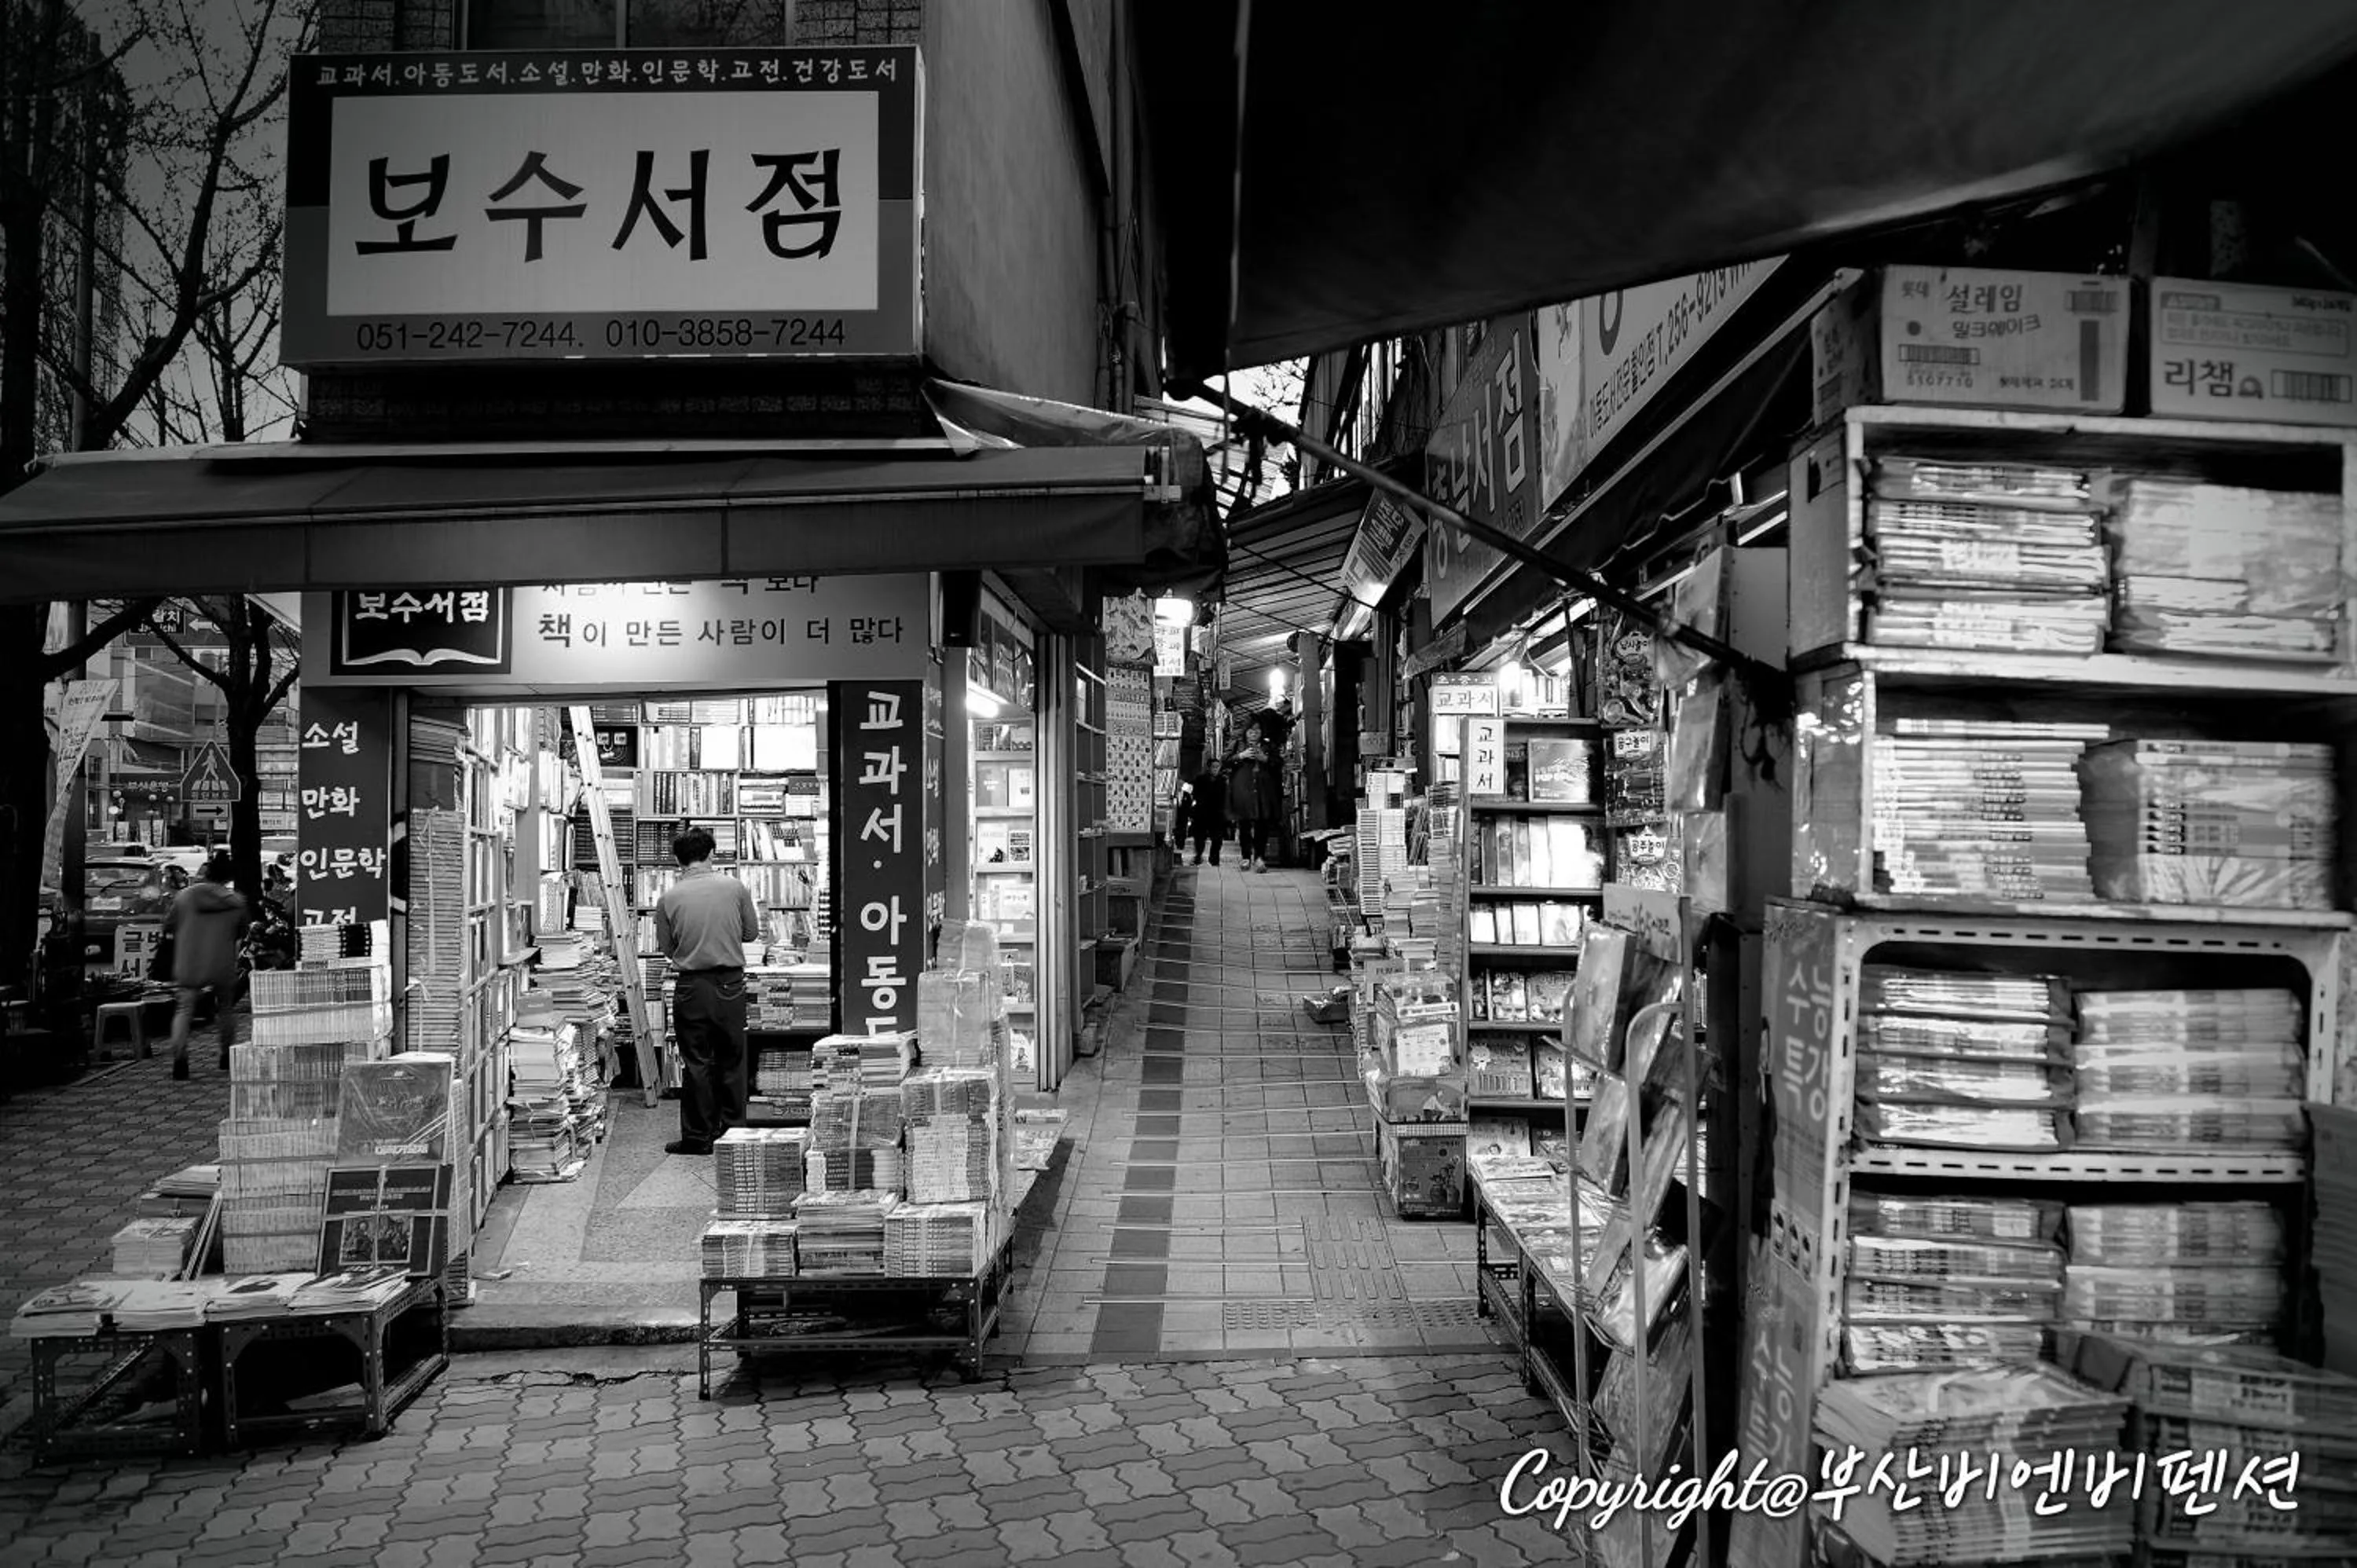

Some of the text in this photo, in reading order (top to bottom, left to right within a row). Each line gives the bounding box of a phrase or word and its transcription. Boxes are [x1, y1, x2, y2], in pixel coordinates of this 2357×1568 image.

[355, 148, 842, 263] 보수서점
[1946, 284, 2023, 314] 설레임
[606, 318, 845, 348] 010-3858-7244
[2163, 359, 2235, 397] 리챔
[355, 591, 489, 623] 보수서점
[538, 614, 903, 648] 책이 만든 사람이 더 많다
[302, 720, 361, 755] 소설
[1477, 726, 1496, 790] 교과서
[302, 786, 361, 819] 만화
[299, 847, 387, 881] 인문학
